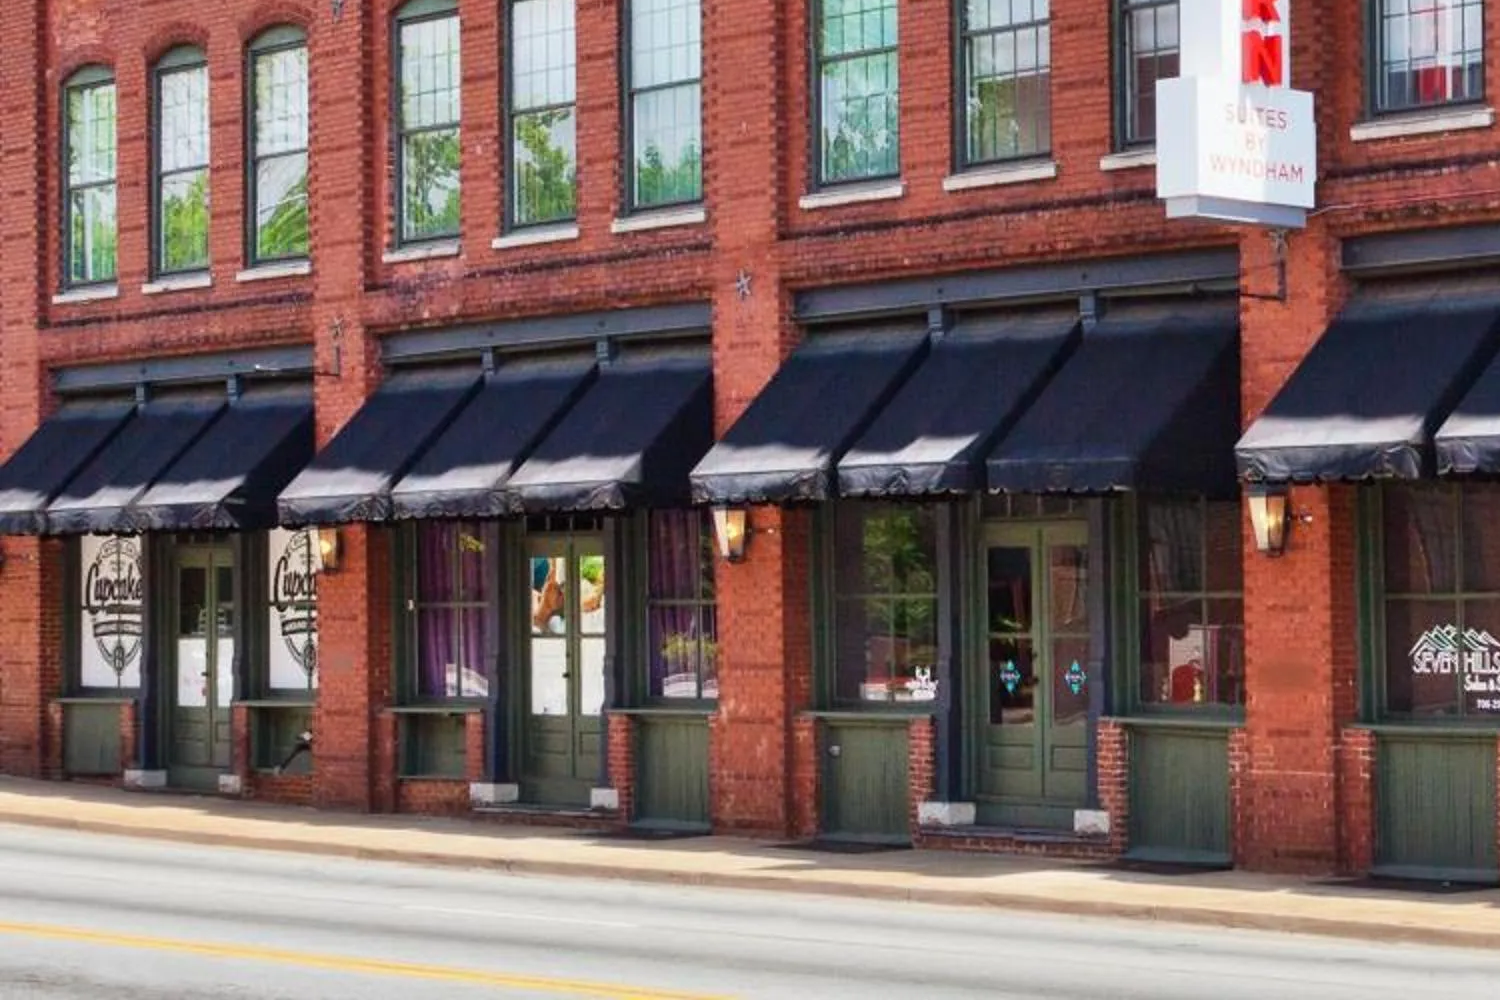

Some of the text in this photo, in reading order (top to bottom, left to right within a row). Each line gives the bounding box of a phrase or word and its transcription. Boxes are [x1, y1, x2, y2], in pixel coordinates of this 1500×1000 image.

[1225, 103, 1289, 129] SUITES
[1245, 131, 1266, 151] BY
[1209, 154, 1304, 184] WYNDHAM
[1413, 651, 1459, 673] SEVEN
